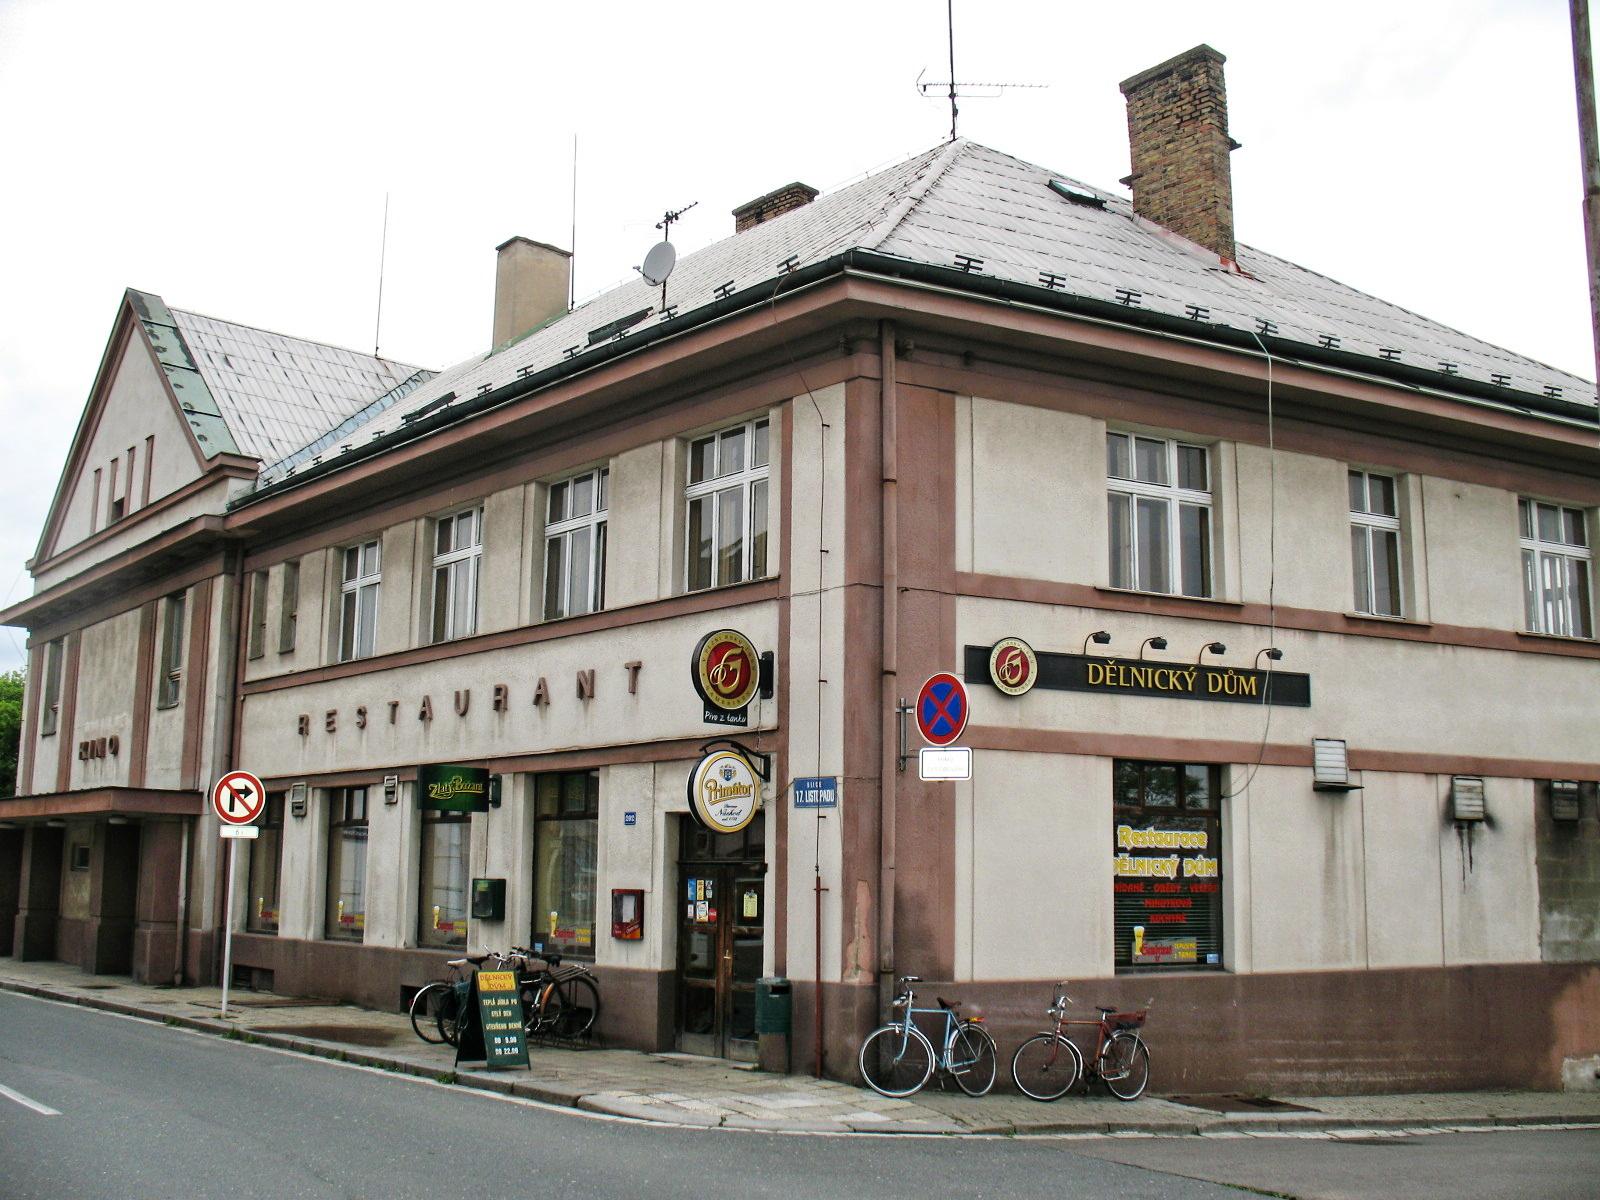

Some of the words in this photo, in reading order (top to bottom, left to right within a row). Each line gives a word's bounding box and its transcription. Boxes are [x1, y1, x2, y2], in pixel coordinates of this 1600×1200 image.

[1087, 660, 1198, 692] DĚLNICKÝ
[1206, 669, 1257, 695] DŮM
[298, 661, 643, 736] RESTAURANT
[704, 710, 719, 721] Pivo
[727, 713, 747, 723] tanku
[79, 735, 120, 761] KINO
[704, 778, 753, 803] Primátor
[796, 790, 804, 803] 17.
[1117, 824, 1209, 851] Restaurace
[1183, 854, 1218, 878] DŮM
